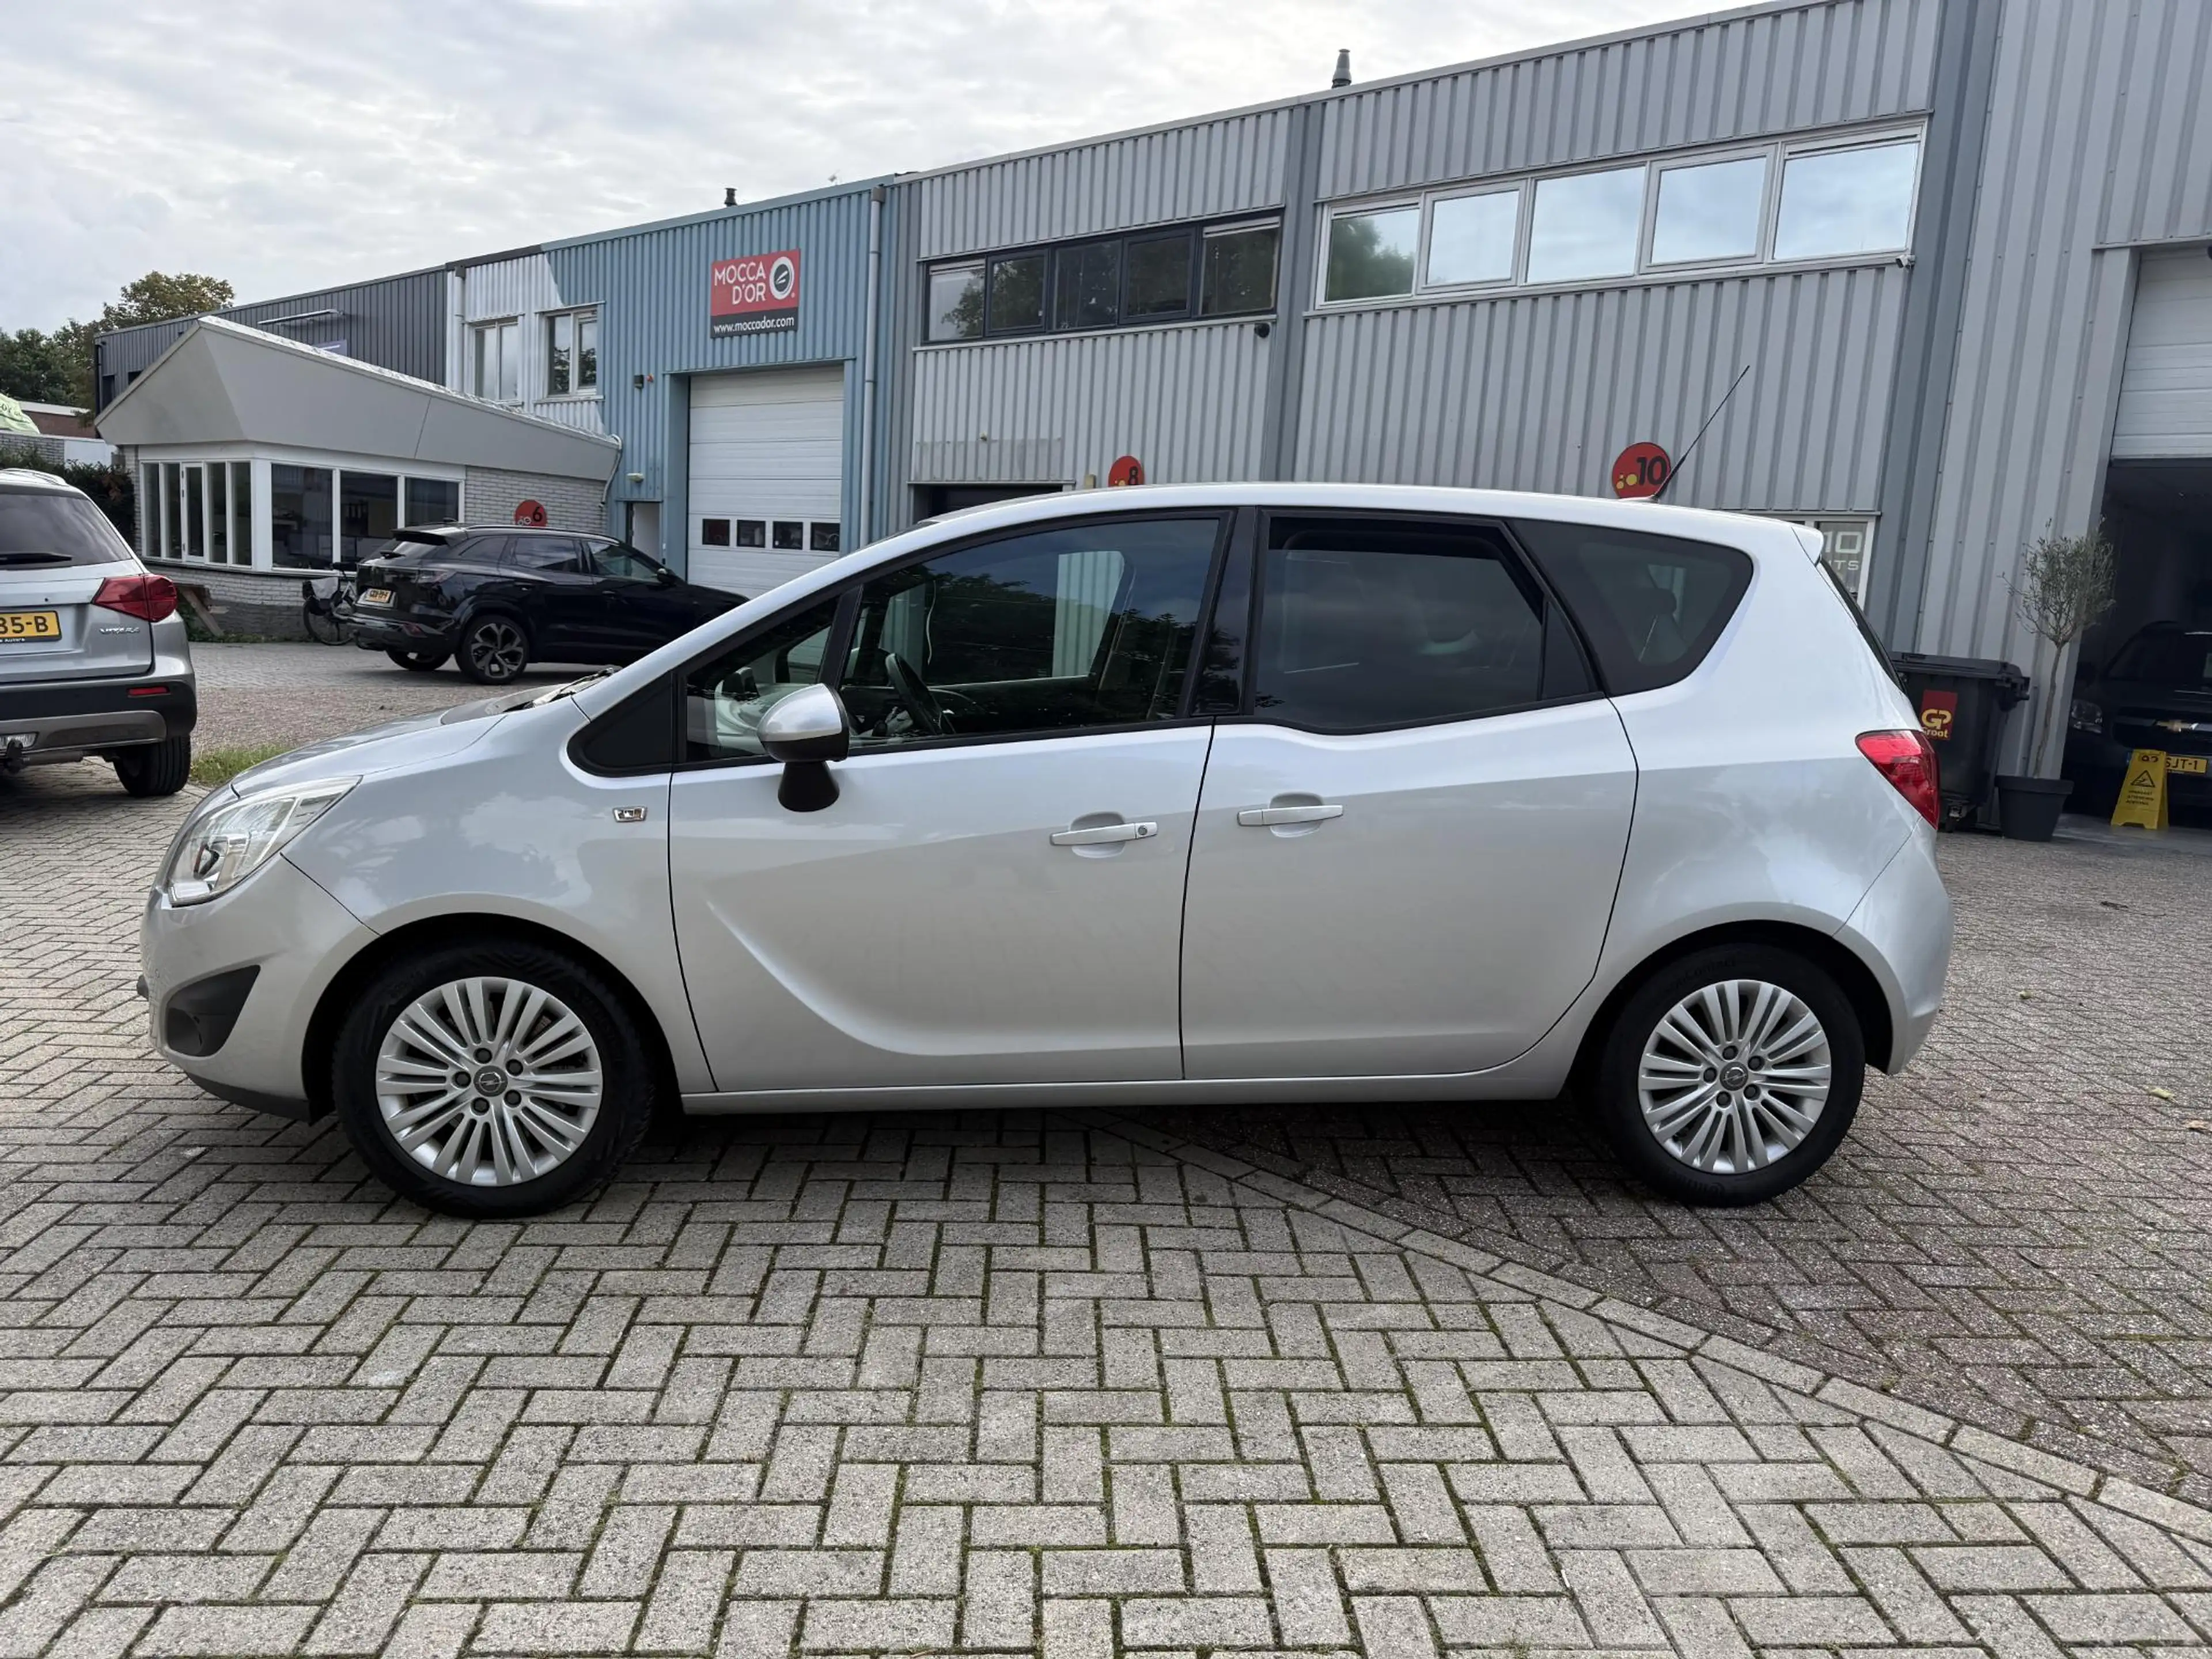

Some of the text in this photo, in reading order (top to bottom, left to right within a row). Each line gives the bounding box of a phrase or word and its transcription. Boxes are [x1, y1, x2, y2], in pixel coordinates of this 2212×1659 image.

[714, 261, 766, 286] MOCCA
[732, 282, 766, 305] D'OR
[714, 316, 795, 334] www.moccador.com
[1128, 465, 1139, 486] 8
[1637, 456, 1667, 485] 10
[532, 506, 543, 522] 6
